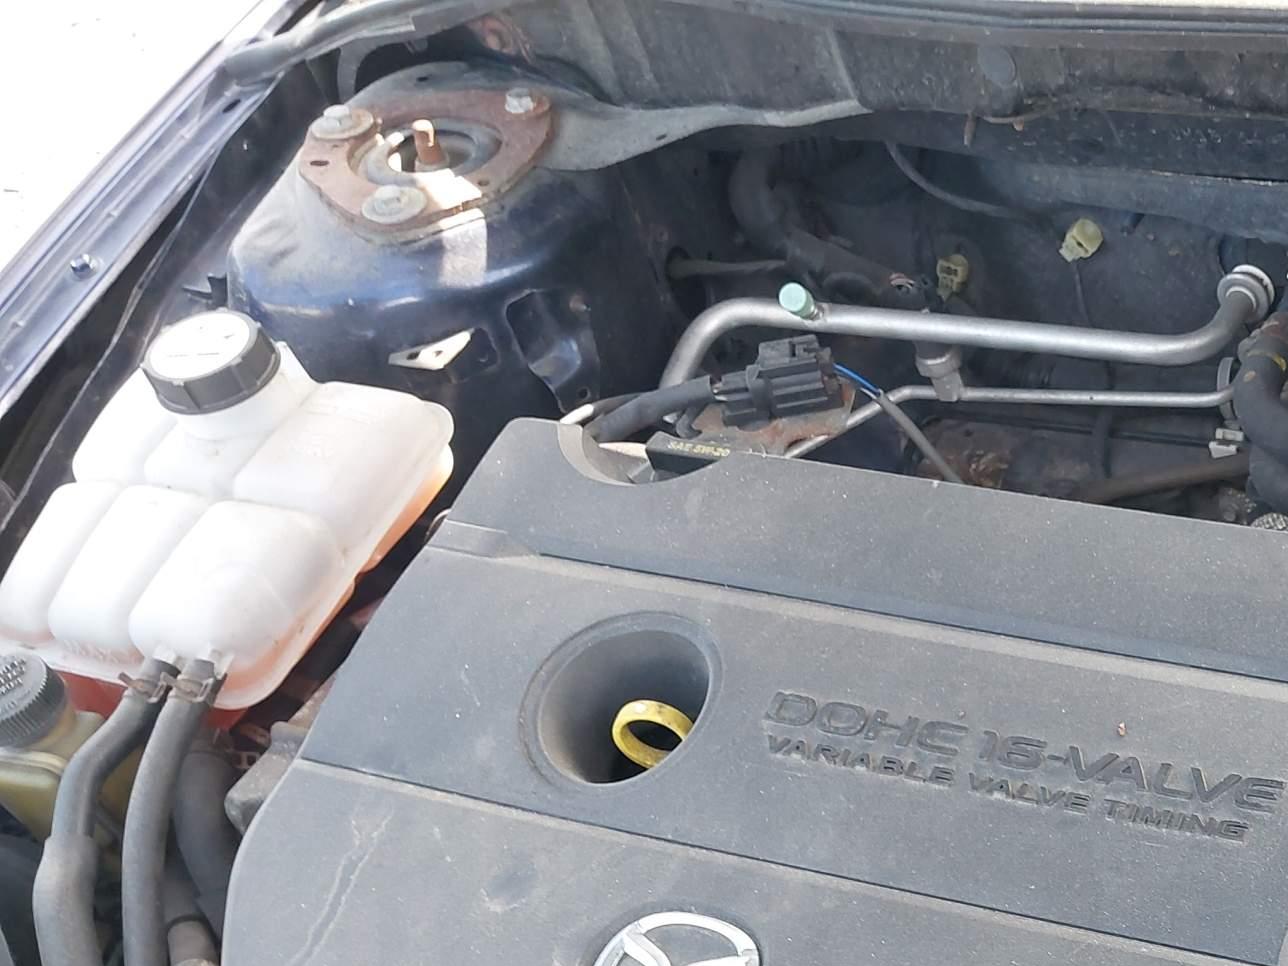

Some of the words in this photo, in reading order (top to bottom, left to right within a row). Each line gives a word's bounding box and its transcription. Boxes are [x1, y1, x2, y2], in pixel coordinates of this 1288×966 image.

[764, 690, 968, 757] DOHC
[767, 733, 956, 788] VARIABLE
[968, 771, 1091, 813] VALVE
[1103, 797, 1250, 842] TIMING
